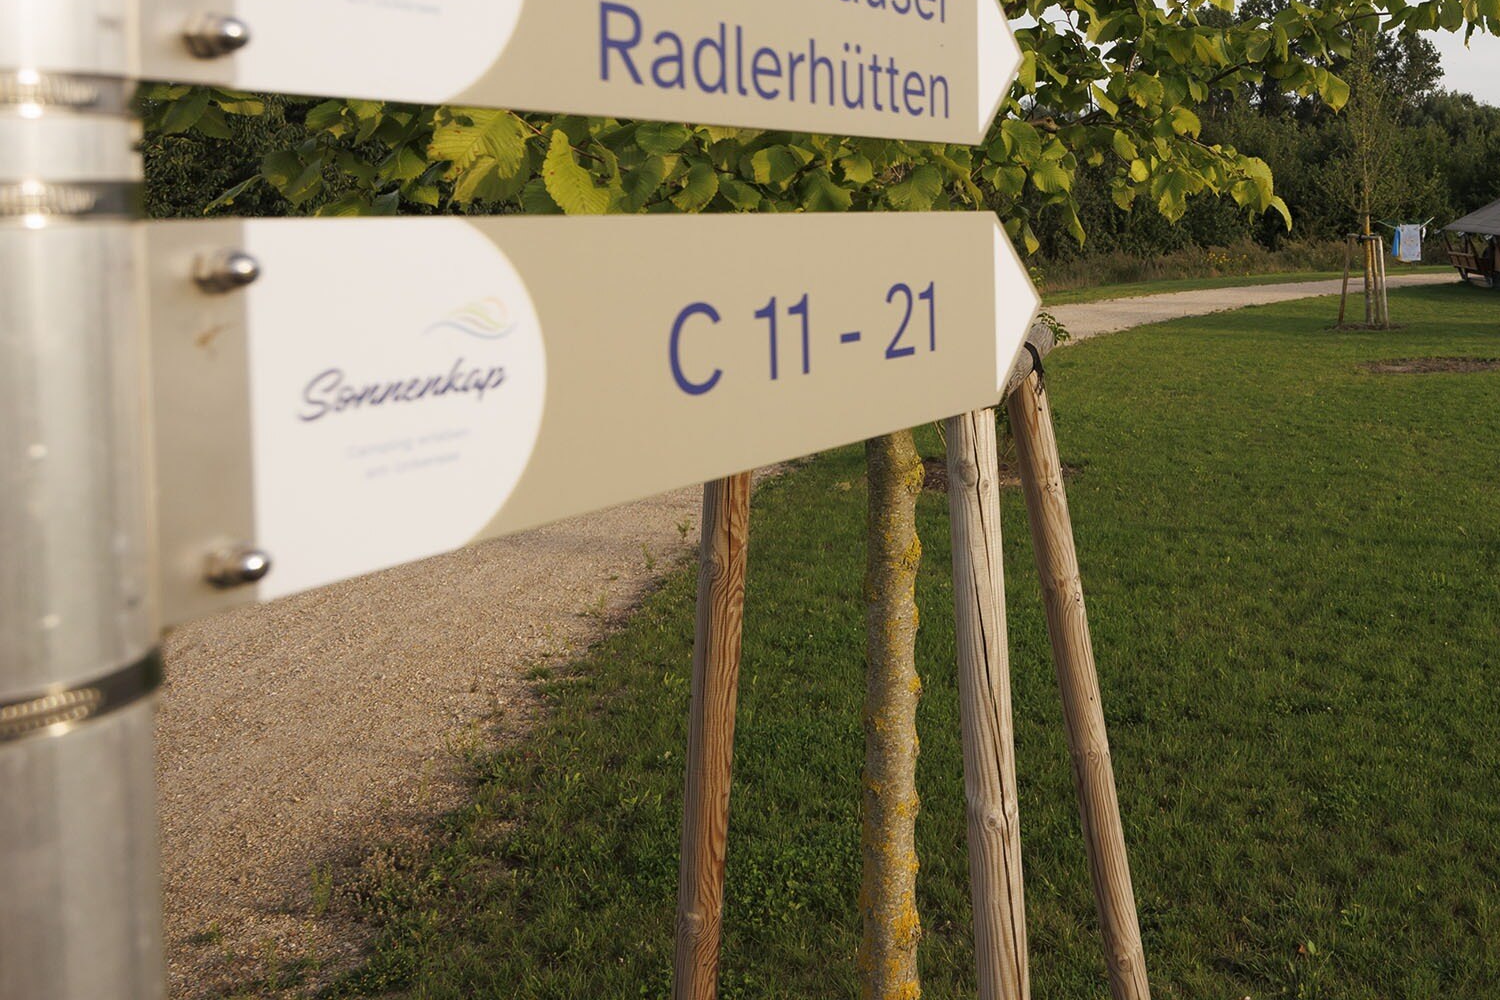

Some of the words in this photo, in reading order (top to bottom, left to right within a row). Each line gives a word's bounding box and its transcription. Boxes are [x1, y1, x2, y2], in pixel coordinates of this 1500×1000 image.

[599, 0, 950, 119] Radlerhütten
[298, 357, 508, 421] Sonnenkap
[669, 302, 723, 395] C
[754, 293, 810, 380] 11
[840, 331, 861, 344] -
[885, 281, 935, 360] 21
